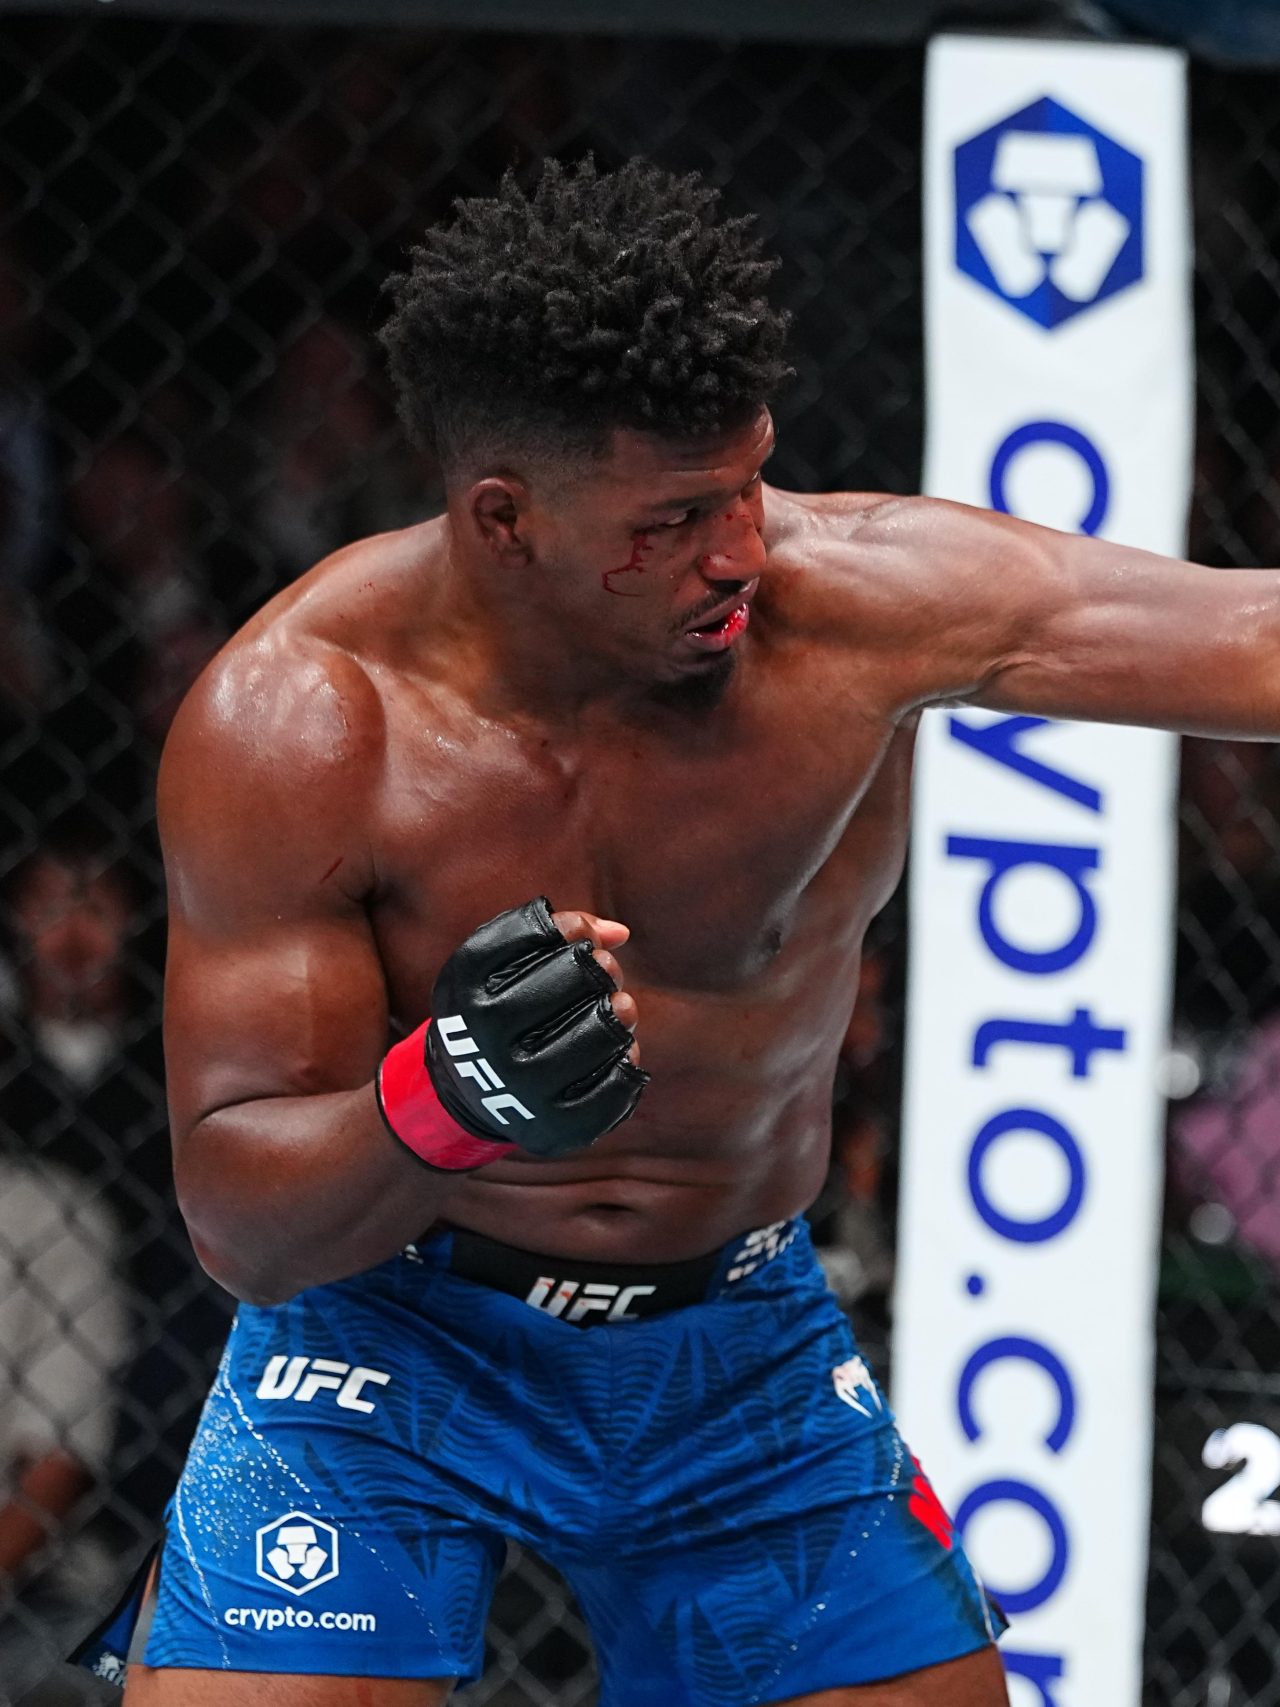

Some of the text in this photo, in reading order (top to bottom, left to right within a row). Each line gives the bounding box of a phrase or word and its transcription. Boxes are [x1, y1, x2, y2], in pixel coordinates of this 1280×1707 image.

[437, 1015, 536, 1125] UFC
[525, 1276, 657, 1322] UFC
[256, 1355, 391, 1415] UFC
[224, 1605, 377, 1632] crypto.com
